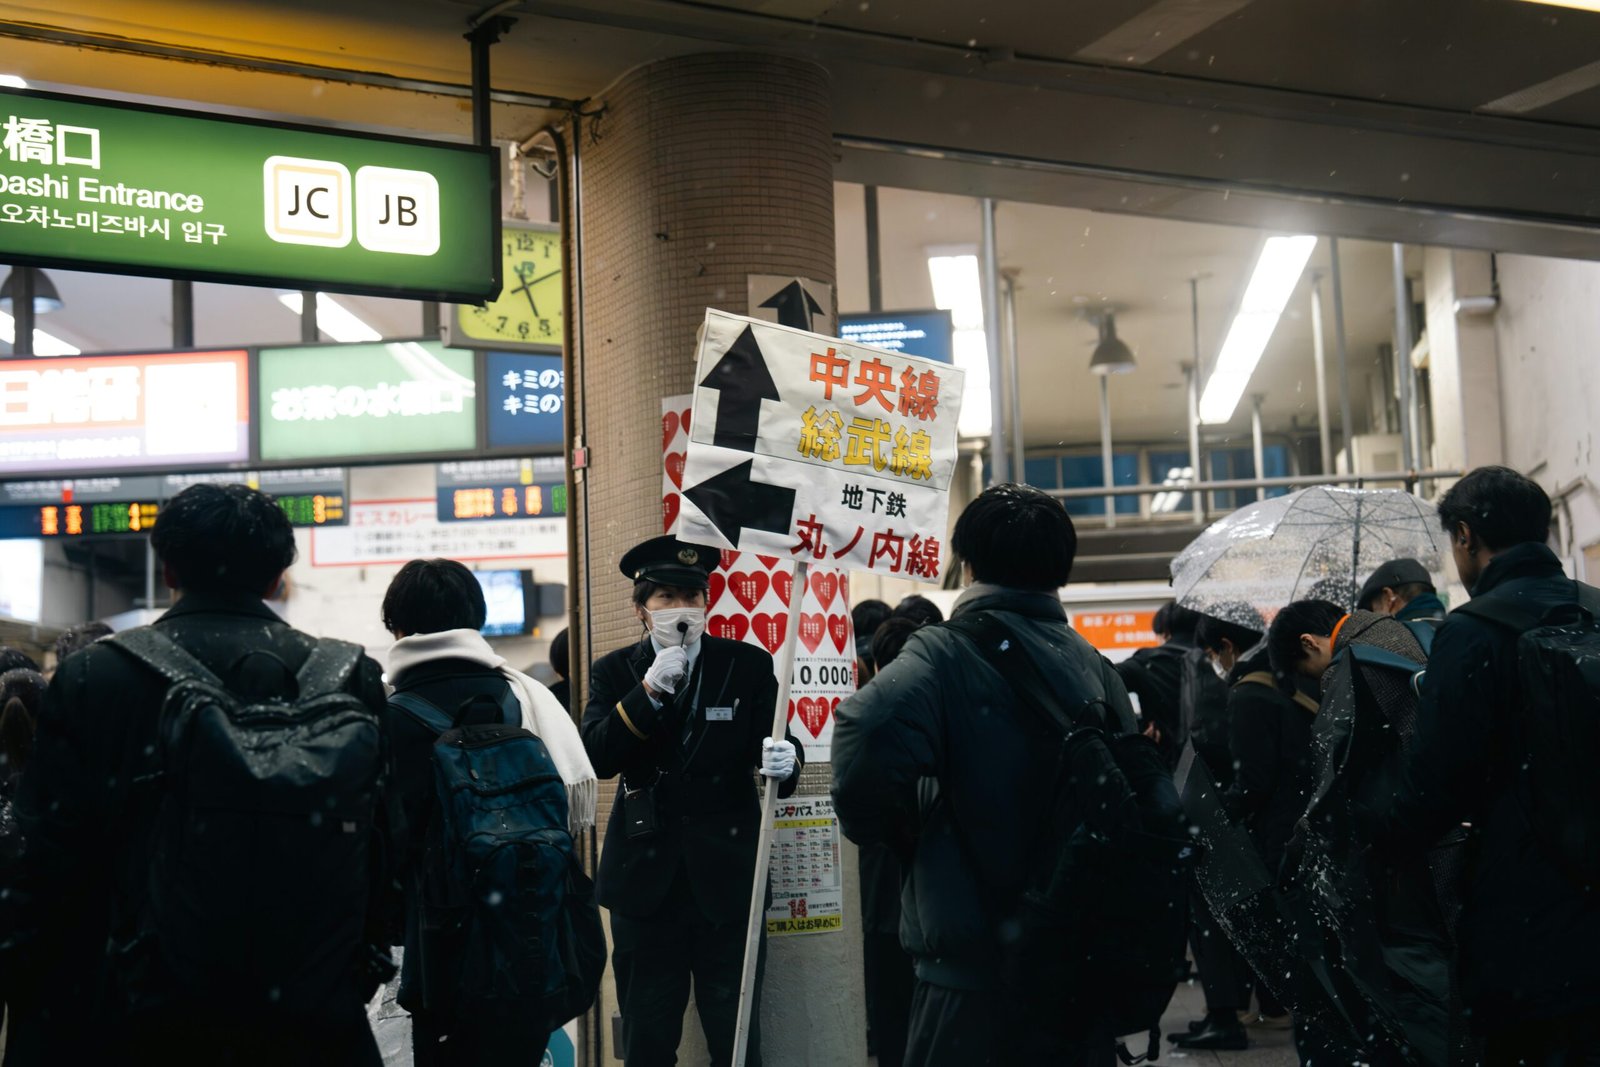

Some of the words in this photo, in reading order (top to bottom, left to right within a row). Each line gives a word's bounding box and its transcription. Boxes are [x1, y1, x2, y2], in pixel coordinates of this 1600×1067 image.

[0, 115, 101, 169] 橋口
[78, 177, 204, 213] Entrance
[286, 184, 330, 219] JC
[378, 194, 418, 227] JB
[0, 203, 170, 240] 오차노미즈바시
[181, 221, 228, 245] 입구
[516, 238, 534, 252] 12
[513, 261, 535, 277] JR
[497, 316, 508, 329] 7
[517, 322, 530, 335] 6
[502, 369, 564, 391] キミの
[808, 347, 942, 423] 中央線
[503, 394, 564, 416] キミの
[797, 405, 933, 481] 総武線
[840, 483, 907, 519] 地下鉄
[790, 513, 941, 579] 丸ノ内線
